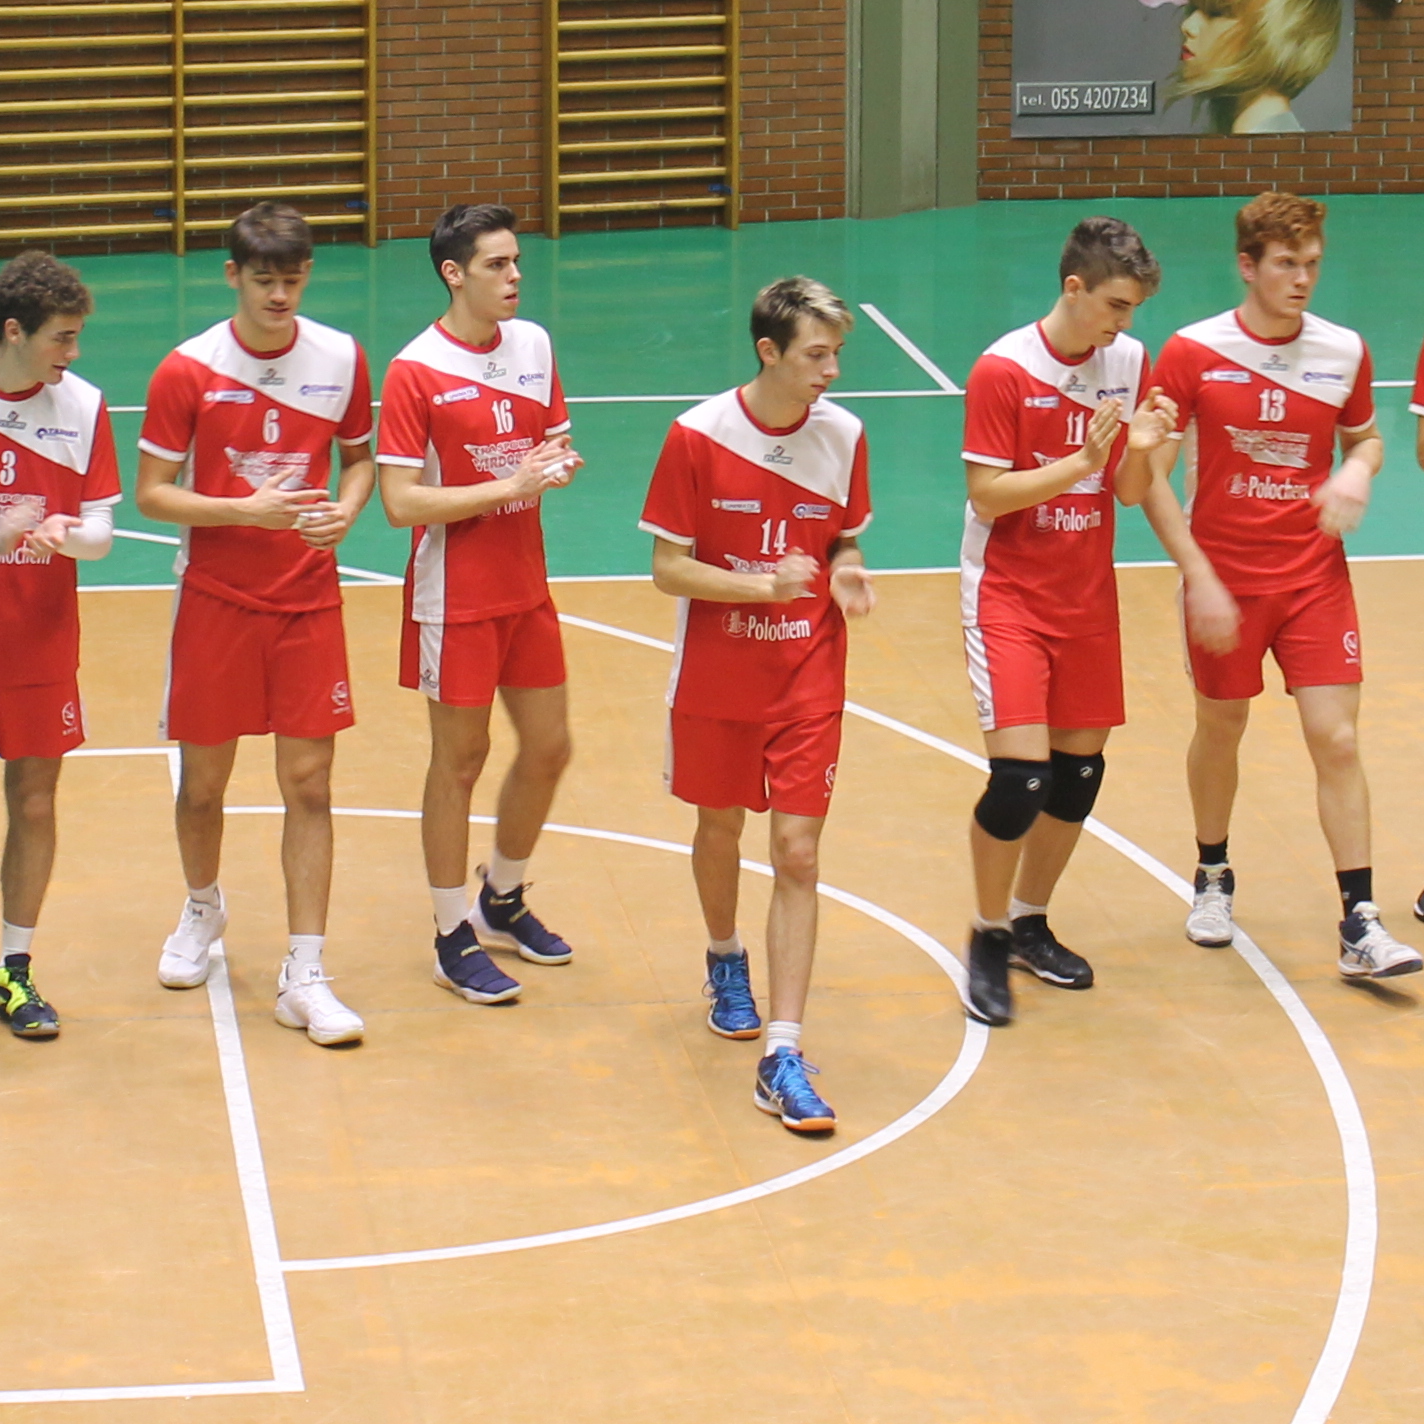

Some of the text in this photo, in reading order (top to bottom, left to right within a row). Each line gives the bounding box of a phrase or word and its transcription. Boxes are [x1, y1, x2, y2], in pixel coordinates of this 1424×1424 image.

[1022, 86, 1148, 110] tel. 055 4207234
[491, 398, 514, 435] 16
[1258, 388, 1287, 423] 13
[262, 408, 281, 445] 6
[760, 518, 787, 555] 14
[747, 614, 811, 642] Polochem
